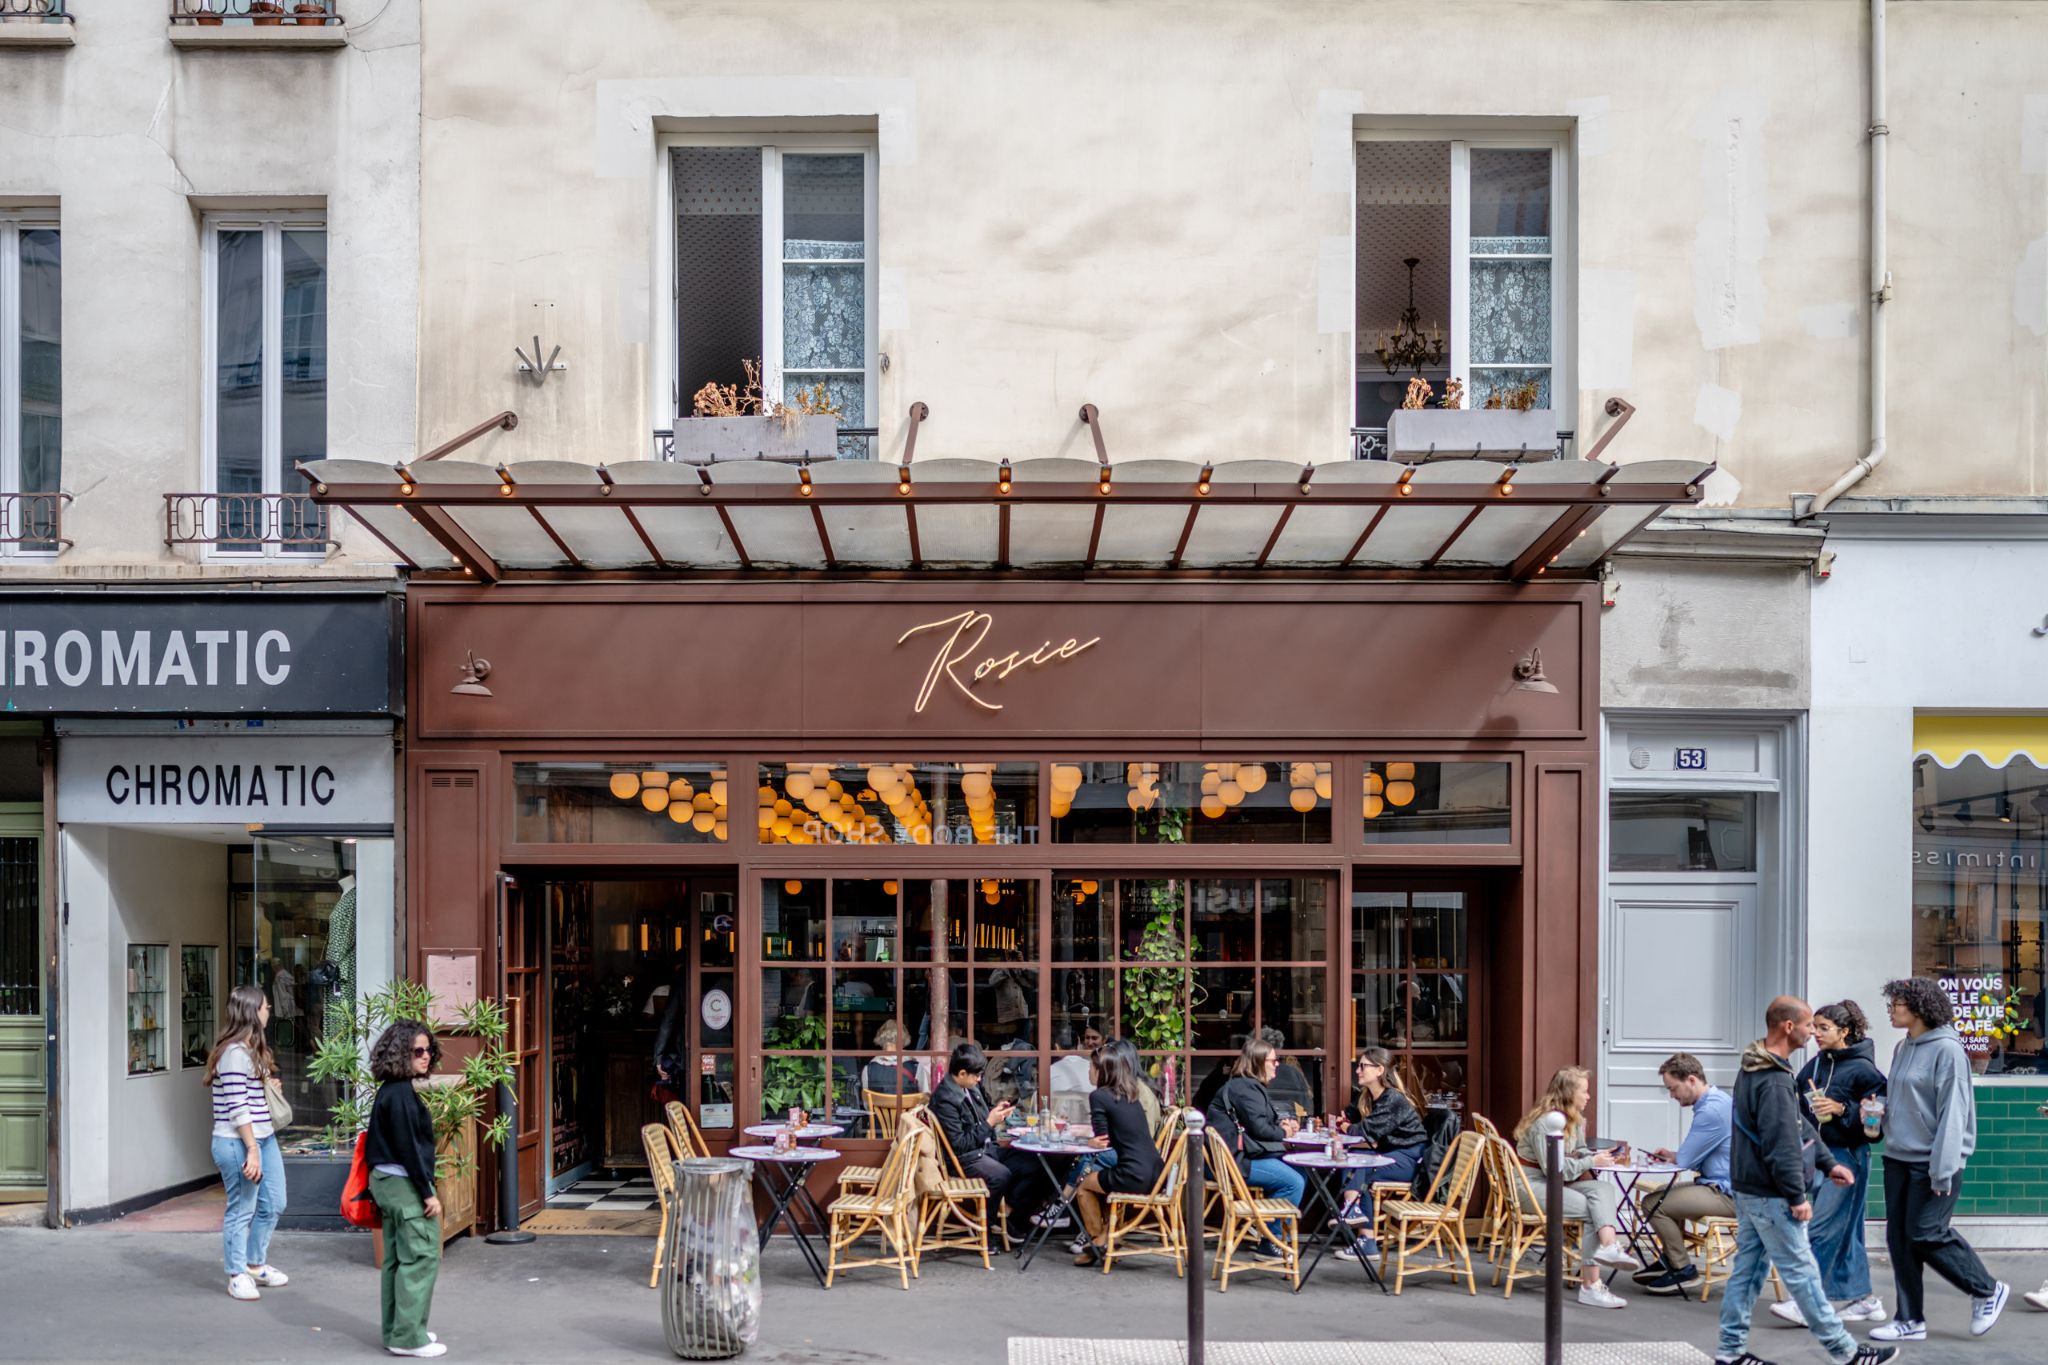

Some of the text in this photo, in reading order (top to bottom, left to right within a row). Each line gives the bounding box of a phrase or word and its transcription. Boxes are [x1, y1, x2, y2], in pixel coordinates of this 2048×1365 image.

[0, 629, 291, 688] ROMATIC
[897, 609, 1102, 713] Rosie
[1680, 749, 1703, 768] 53
[106, 763, 336, 807] CHROMATIC
[1961, 977, 2003, 991] VOUS
[1961, 992, 1979, 1004] LE
[1952, 1005, 2005, 1018] DE VUE
[1963, 1043, 1989, 1051] -VOUS.
[1968, 1036, 1989, 1044] SANS
